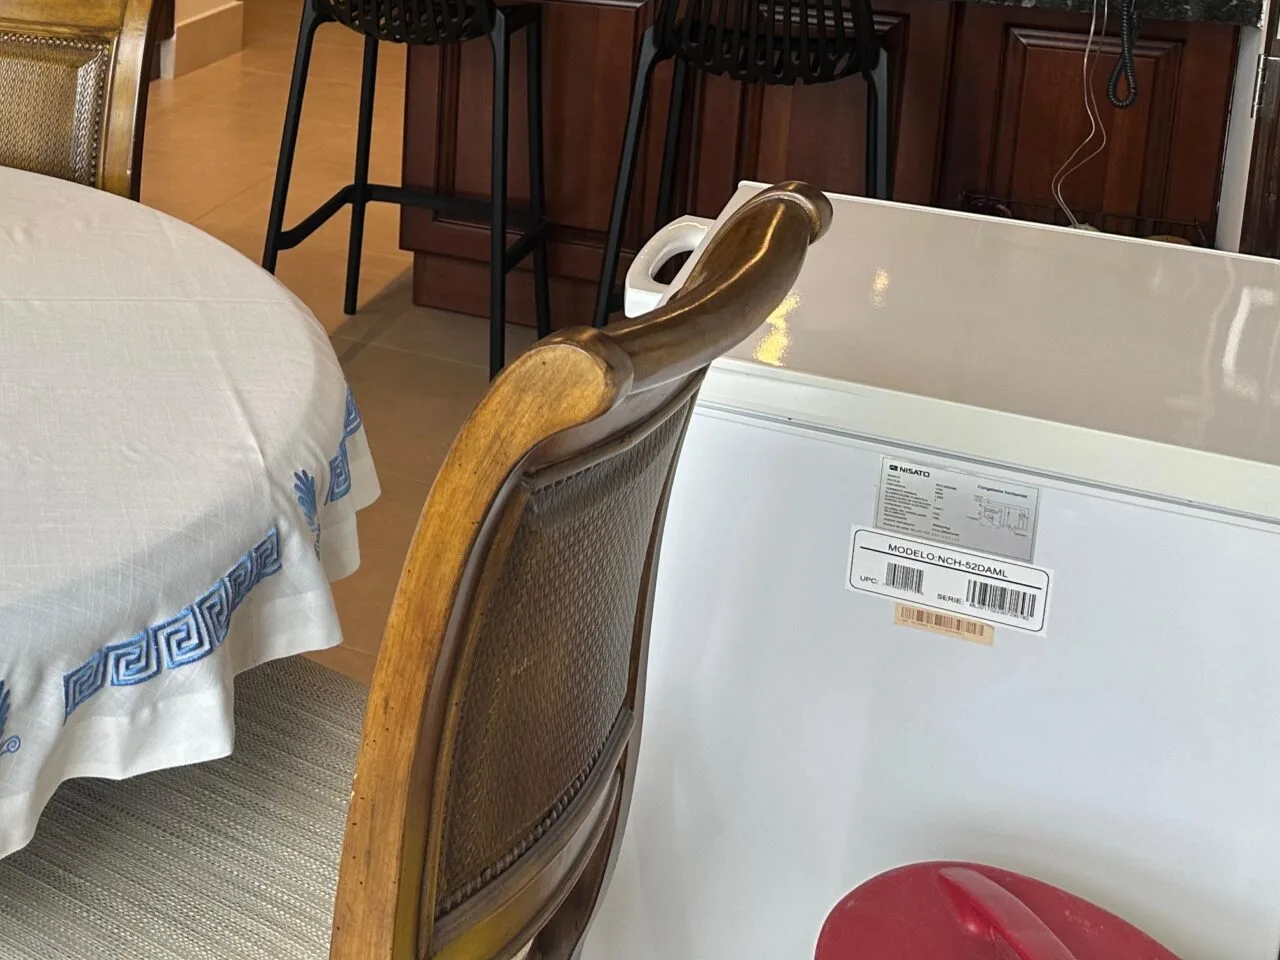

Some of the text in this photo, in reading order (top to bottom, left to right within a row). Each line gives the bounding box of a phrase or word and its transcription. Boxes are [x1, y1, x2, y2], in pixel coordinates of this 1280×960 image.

[899, 466, 930, 478] NISATO
[859, 575, 880, 585] UPC:
[936, 593, 964, 605] SERIE:
